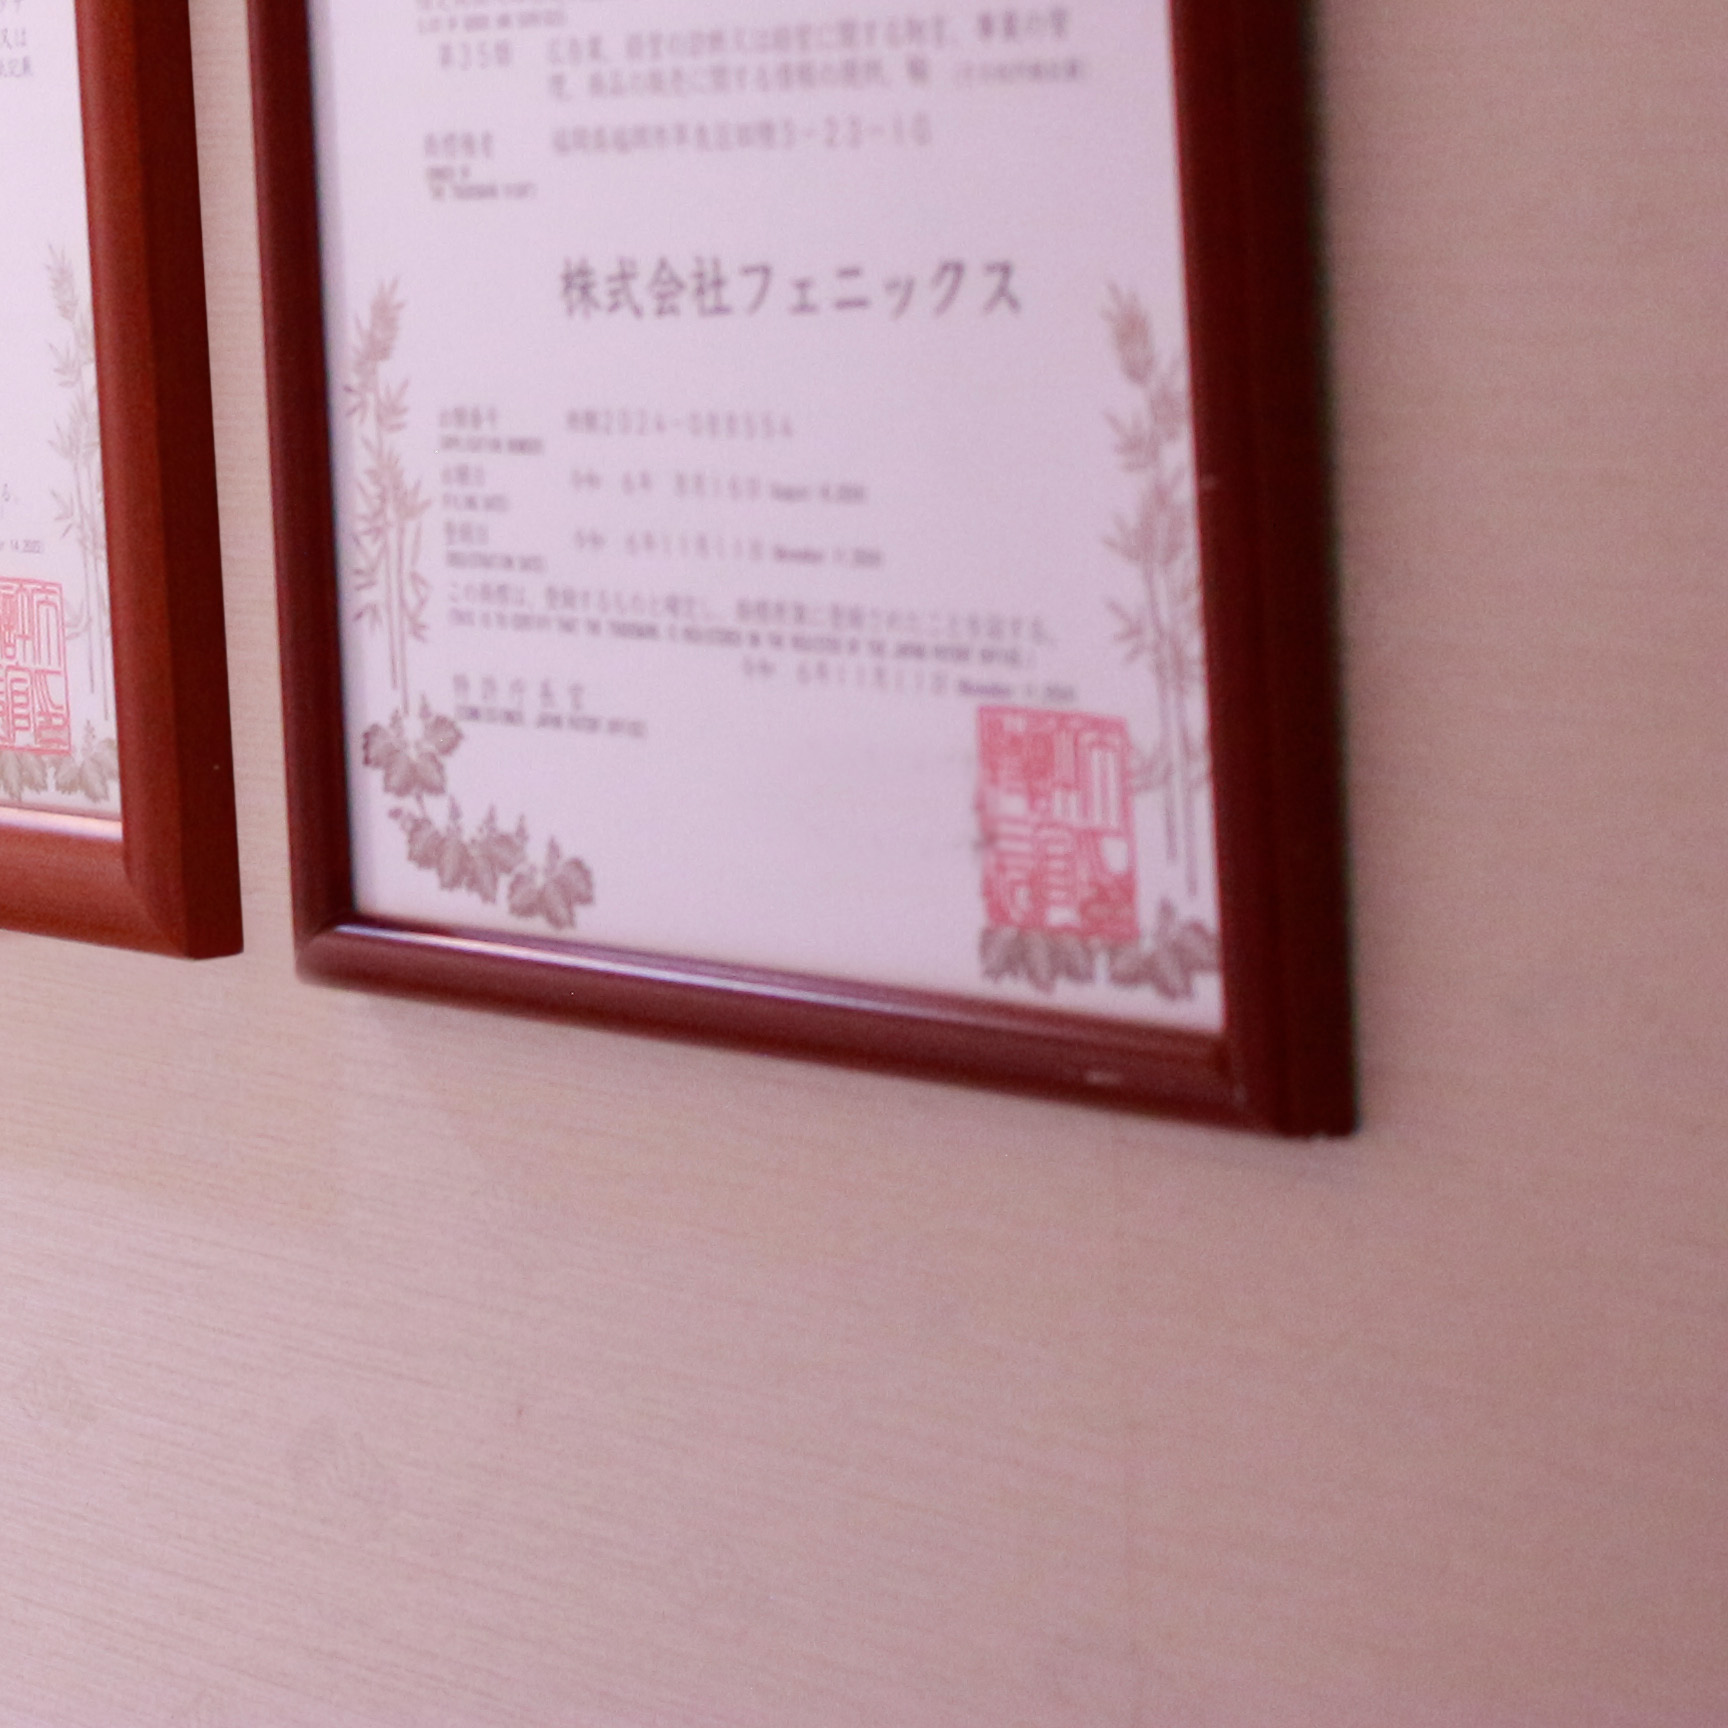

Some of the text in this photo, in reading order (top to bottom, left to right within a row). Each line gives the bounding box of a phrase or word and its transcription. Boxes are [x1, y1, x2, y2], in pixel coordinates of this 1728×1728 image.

[560, 254, 1023, 321] 株式会社フェニックス
